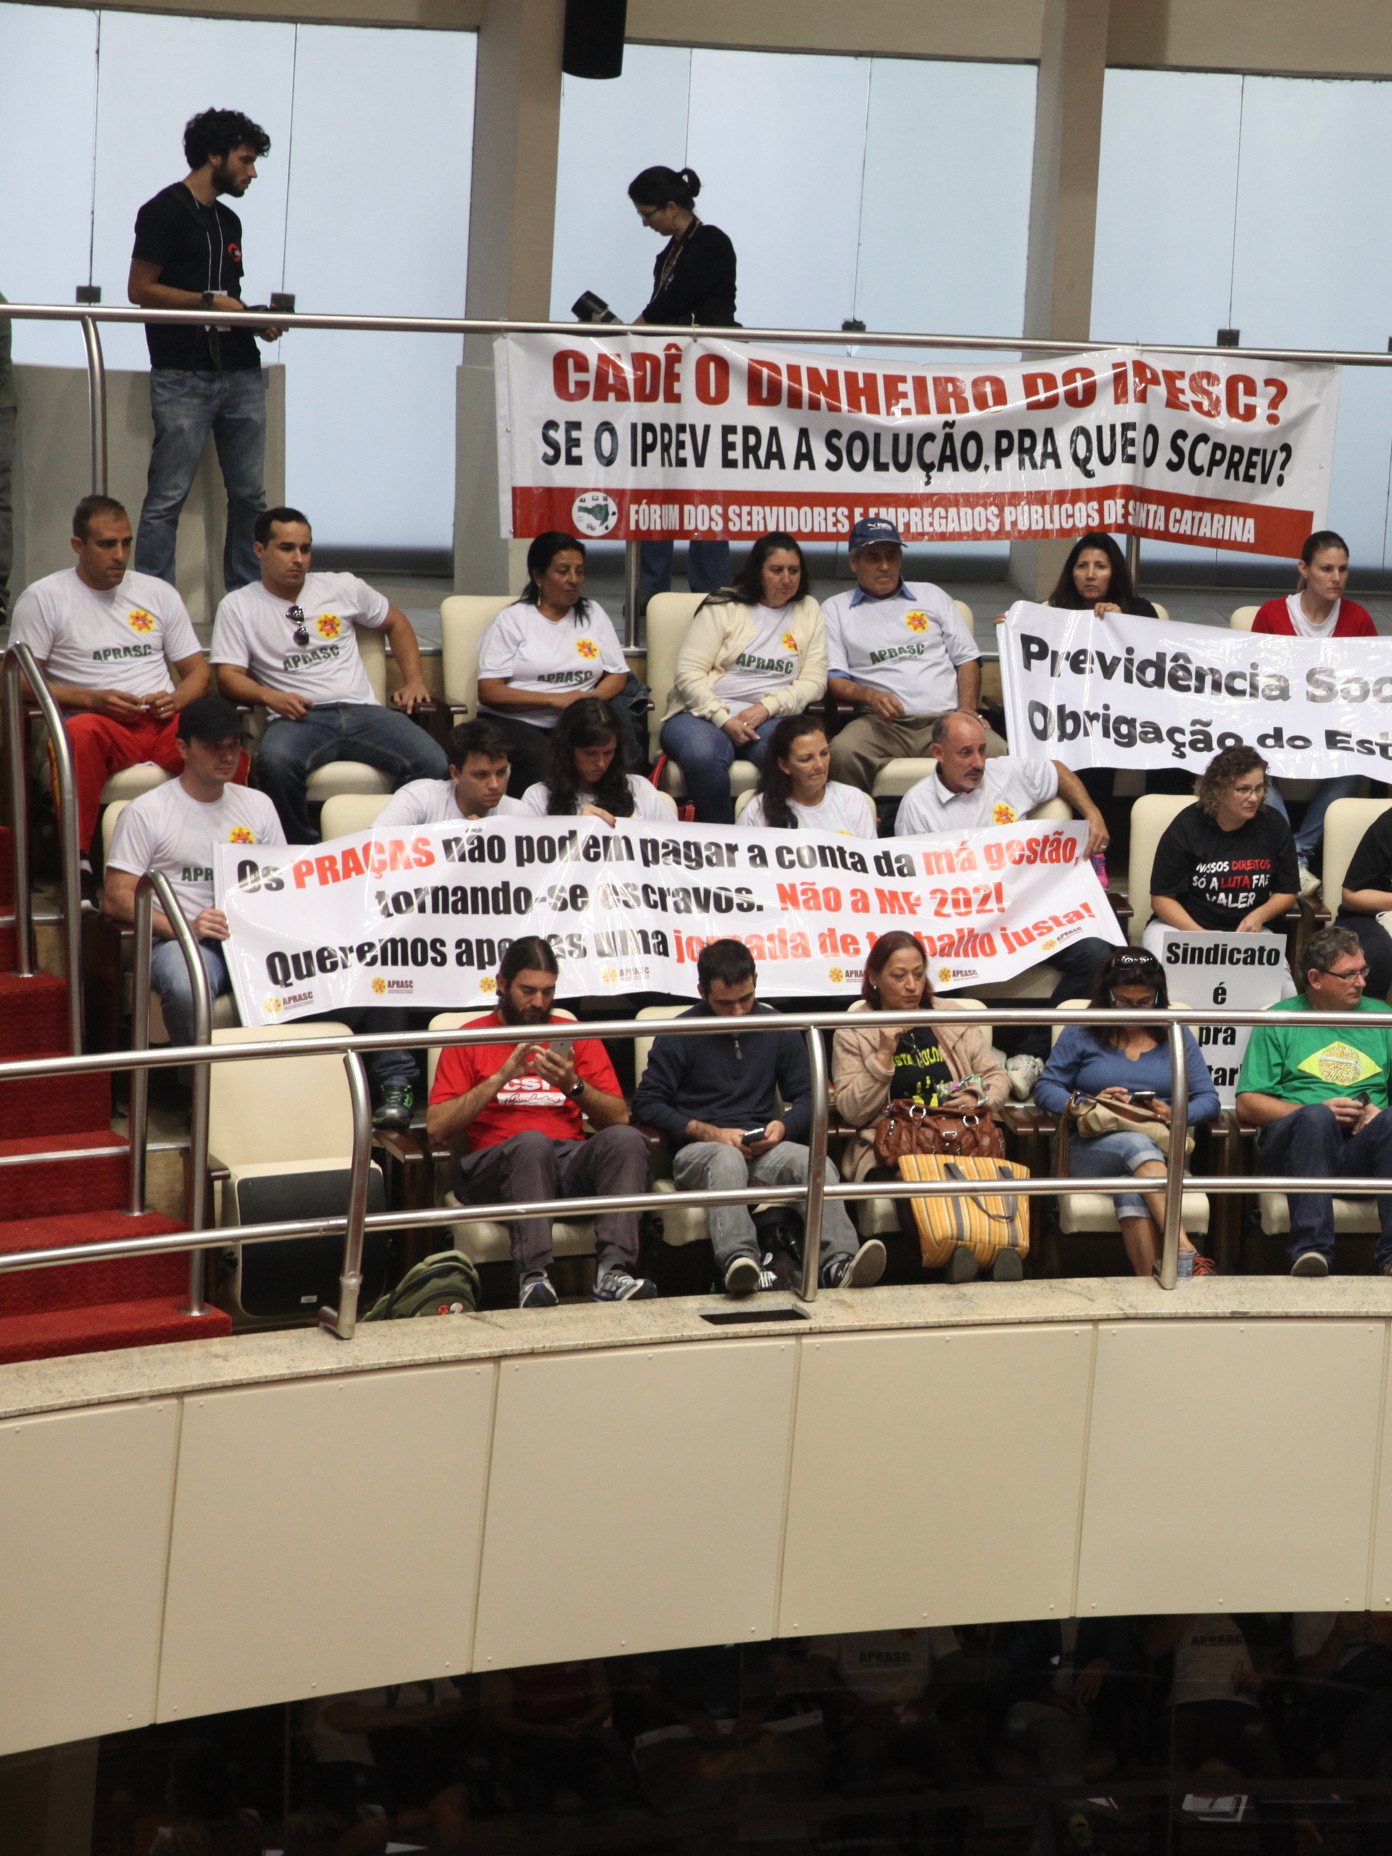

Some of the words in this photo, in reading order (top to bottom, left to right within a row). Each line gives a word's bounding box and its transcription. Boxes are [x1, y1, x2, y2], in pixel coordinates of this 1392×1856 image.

[552, 342, 683, 403] CADÊ
[695, 353, 730, 405] O
[746, 358, 1009, 416] DINHEIRO
[1022, 366, 1097, 411] DO
[1112, 359, 1289, 426] IPESC?
[541, 419, 583, 466] SE
[594, 420, 619, 467] O
[630, 421, 711, 468] IPREV
[721, 425, 786, 470] ERA
[793, 427, 817, 471] A
[995, 427, 1062, 471] PRA
[1069, 421, 1137, 478] QUE
[1142, 423, 1160, 468] O
[1165, 428, 1293, 487] SCPREV?
[629, 499, 680, 532] FÓRUM
[697, 504, 724, 532] DOS
[728, 507, 851, 533] SERVIDORES
[1004, 489, 1100, 531] PÚBLICOS
[1103, 498, 1126, 525] DE
[1168, 507, 1256, 544] CATARINA
[93, 643, 153, 662] APRASC
[736, 653, 794, 675] APRASC
[869, 643, 925, 665] APRASC
[1020, 633, 1292, 702] Previdência
[1027, 699, 1243, 760] Obrigação
[1258, 726, 1312, 750] do
[237, 859, 285, 893] Os
[290, 836, 436, 889] PRAÇAS
[441, 827, 507, 863] não
[514, 829, 635, 868] podem
[639, 835, 739, 871] pagar
[748, 843, 769, 869] a
[775, 843, 869, 875] conta
[873, 849, 917, 878] da
[922, 840, 977, 877] má
[983, 830, 1080, 872] gestão,
[1192, 874, 1207, 889] SÓ
[1209, 877, 1219, 891] A
[1220, 875, 1251, 889] LUTA
[375, 880, 589, 918] tornando-se
[597, 880, 764, 915] escravos.
[775, 881, 843, 913] Não
[850, 886, 870, 914] a
[928, 881, 1005, 918] 202!
[265, 936, 447, 988] Queremos
[594, 928, 670, 959] uma
[818, 927, 861, 958] de
[999, 901, 1096, 955] justa!
[1166, 942, 1281, 967] Sindicato
[387, 980, 414, 989] APRASC
[1212, 982, 1228, 1005] é
[1198, 1026, 1237, 1047] pra
